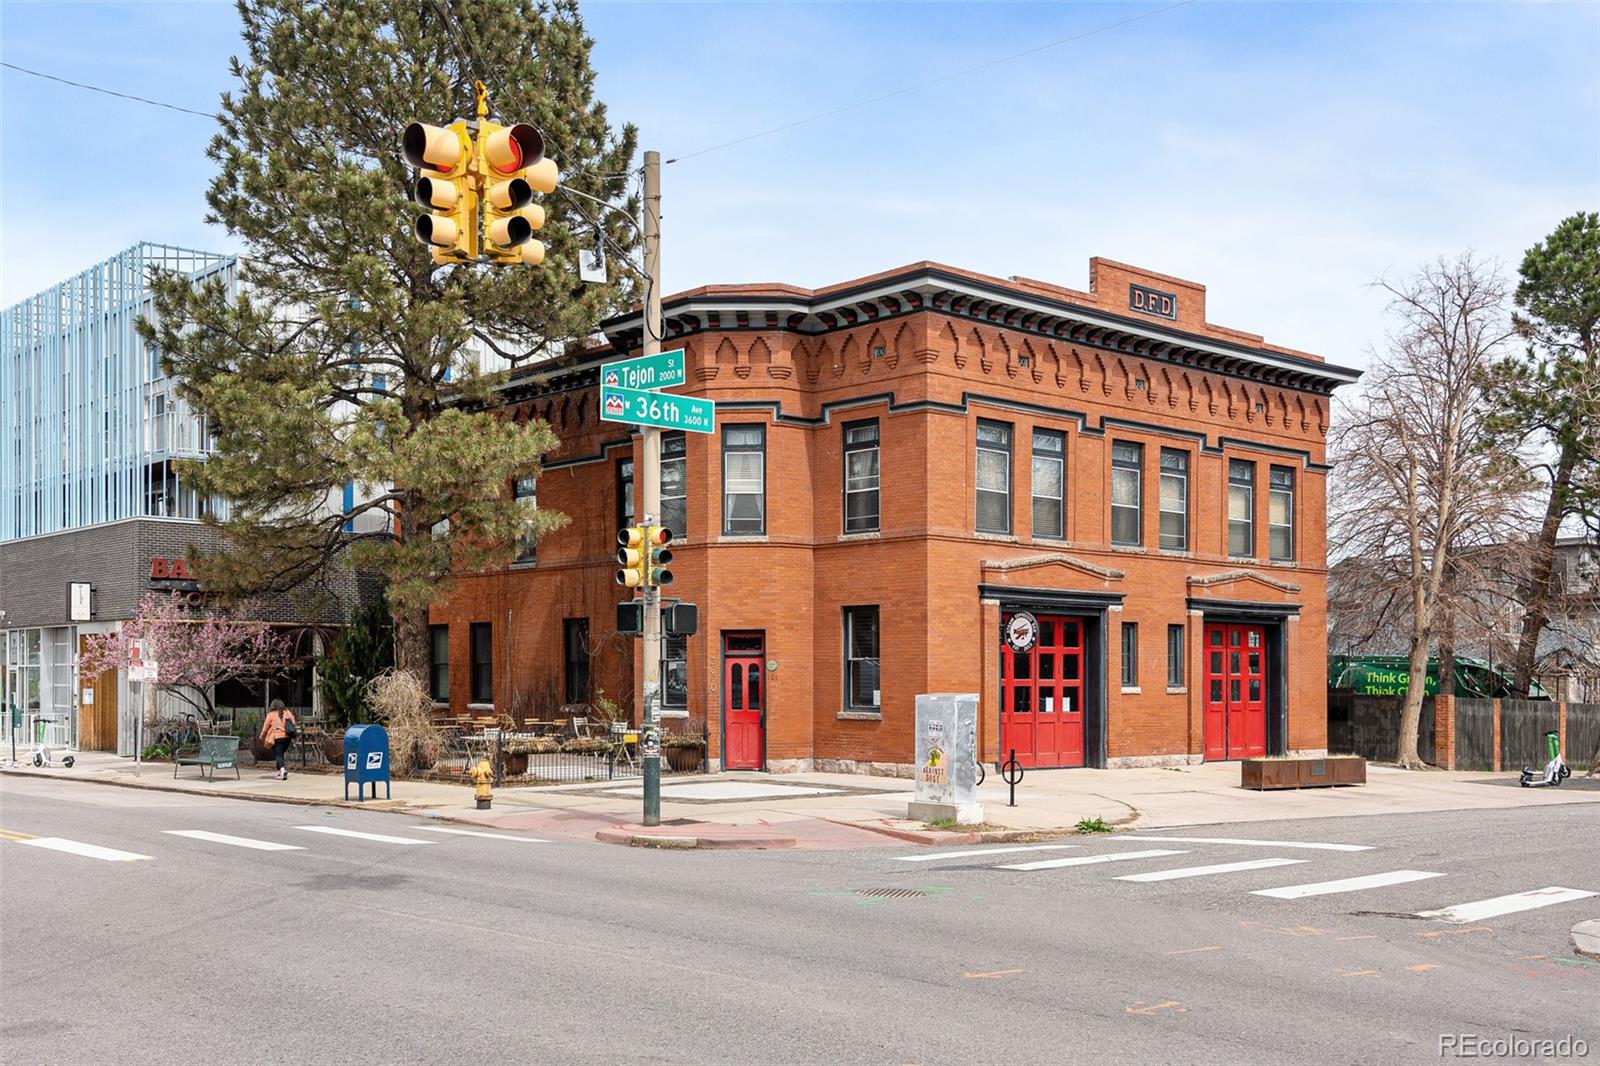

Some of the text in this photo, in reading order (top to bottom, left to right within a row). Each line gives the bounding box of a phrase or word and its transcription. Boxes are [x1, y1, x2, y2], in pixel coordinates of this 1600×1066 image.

[667, 358, 675, 368] St
[622, 365, 682, 388] Tejon 2000 W
[625, 396, 709, 426] W 36th 3600 N
[691, 405, 703, 414] Ave
[1366, 672, 1437, 687] Think Grn,
[1365, 685, 1429, 696] Think Cln
